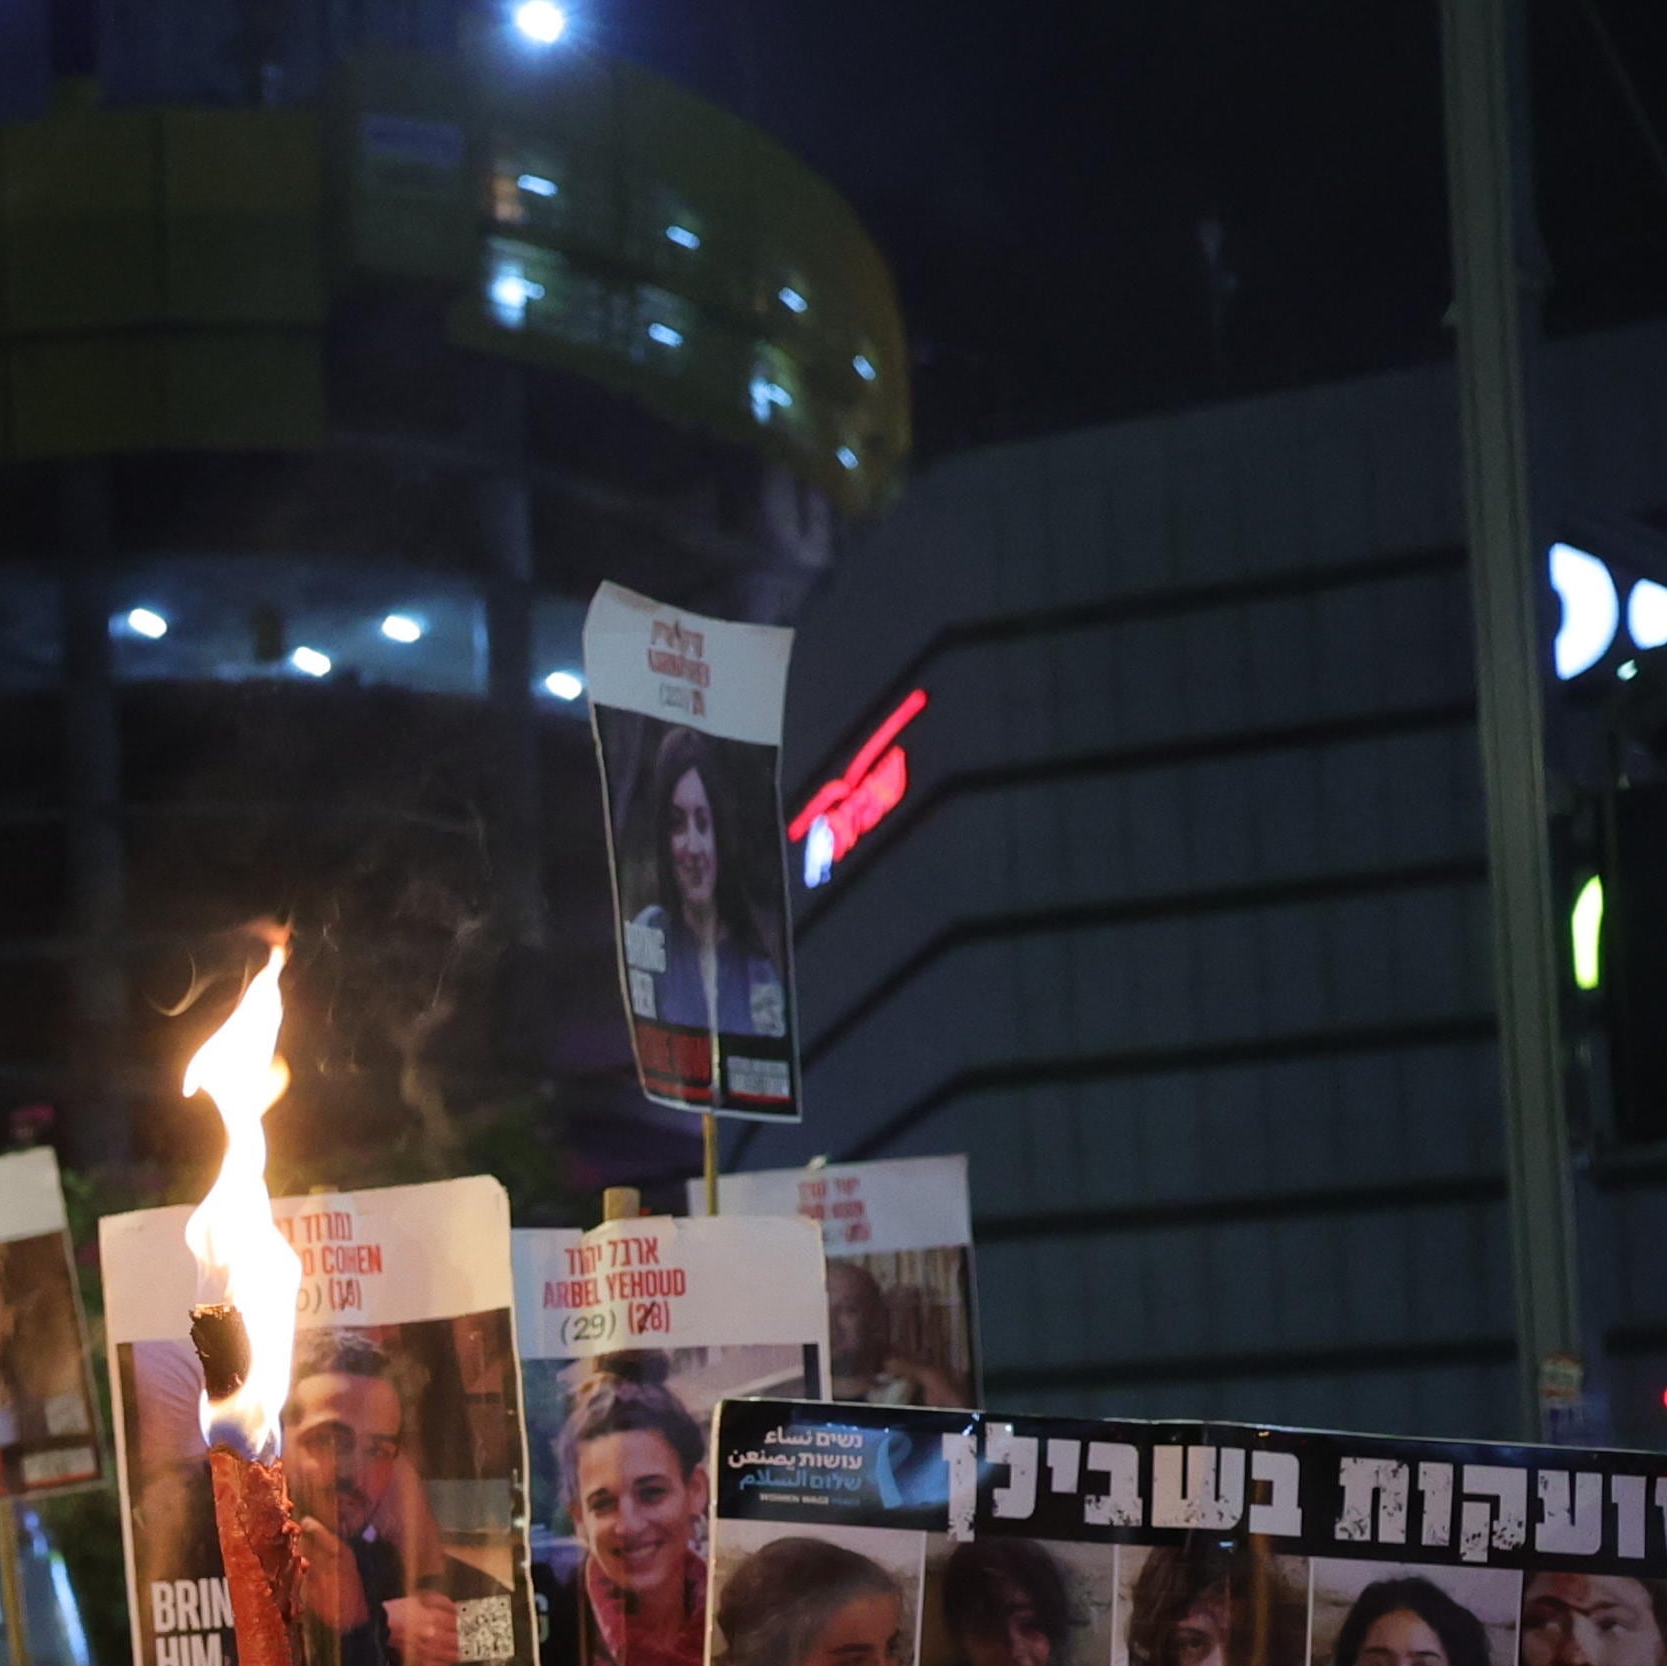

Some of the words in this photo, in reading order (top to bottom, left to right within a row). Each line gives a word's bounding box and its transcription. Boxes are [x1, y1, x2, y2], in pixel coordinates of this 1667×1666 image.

[321, 1244, 383, 1275] COHEN
[607, 1237, 660, 1268] ארבל
[543, 1277, 601, 1309] ARBEL
[606, 1268, 687, 1300] YEHOUD
[560, 1310, 617, 1345] (29)
[764, 1426, 812, 1446] نساء
[816, 1431, 863, 1449] נשים
[798, 1452, 863, 1470] עושות
[810, 1471, 862, 1490] שלום
[942, 1422, 1302, 1542] בשבילן
[1334, 1456, 1667, 1562] ועקות
[152, 1577, 235, 1633] BRIN
